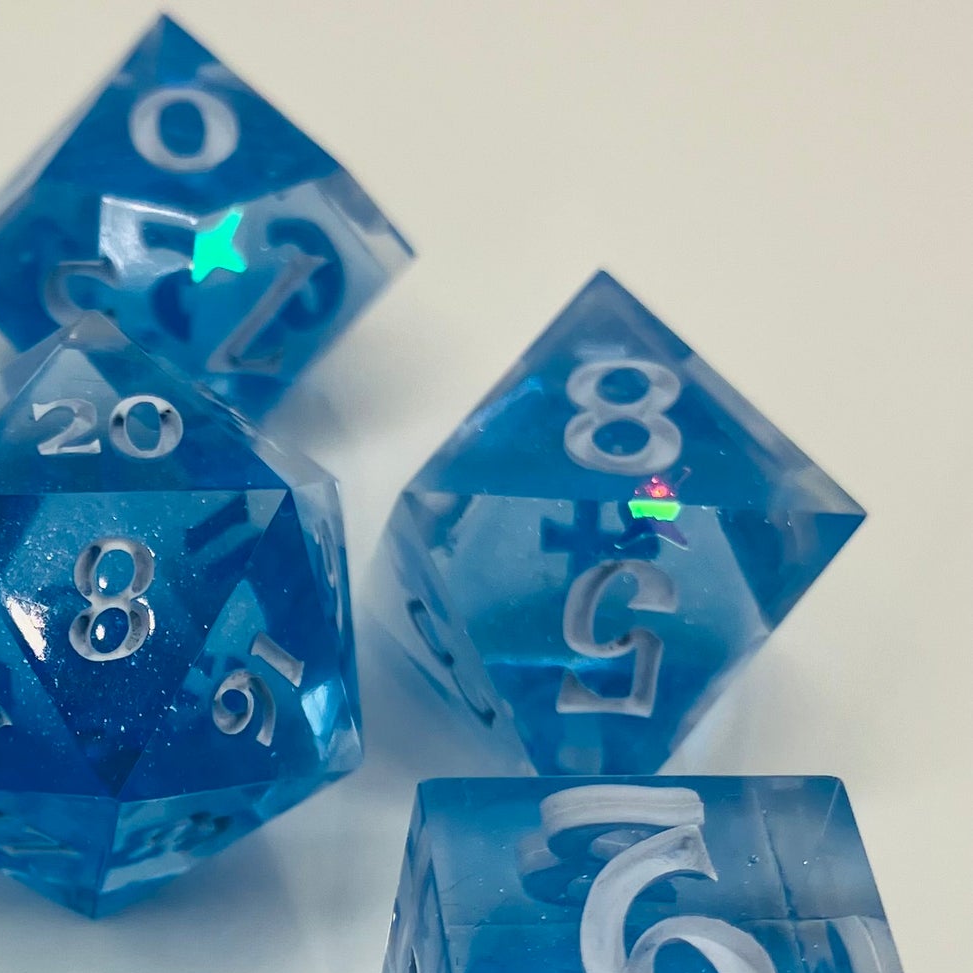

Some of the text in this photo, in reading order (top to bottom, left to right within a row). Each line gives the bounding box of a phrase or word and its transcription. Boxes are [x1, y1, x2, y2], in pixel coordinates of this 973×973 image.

[129, 87, 240, 172] 0
[32, 394, 183, 459] 20
[564, 360, 682, 475] 8
[68, 538, 155, 661] 8
[556, 559, 677, 718] 5
